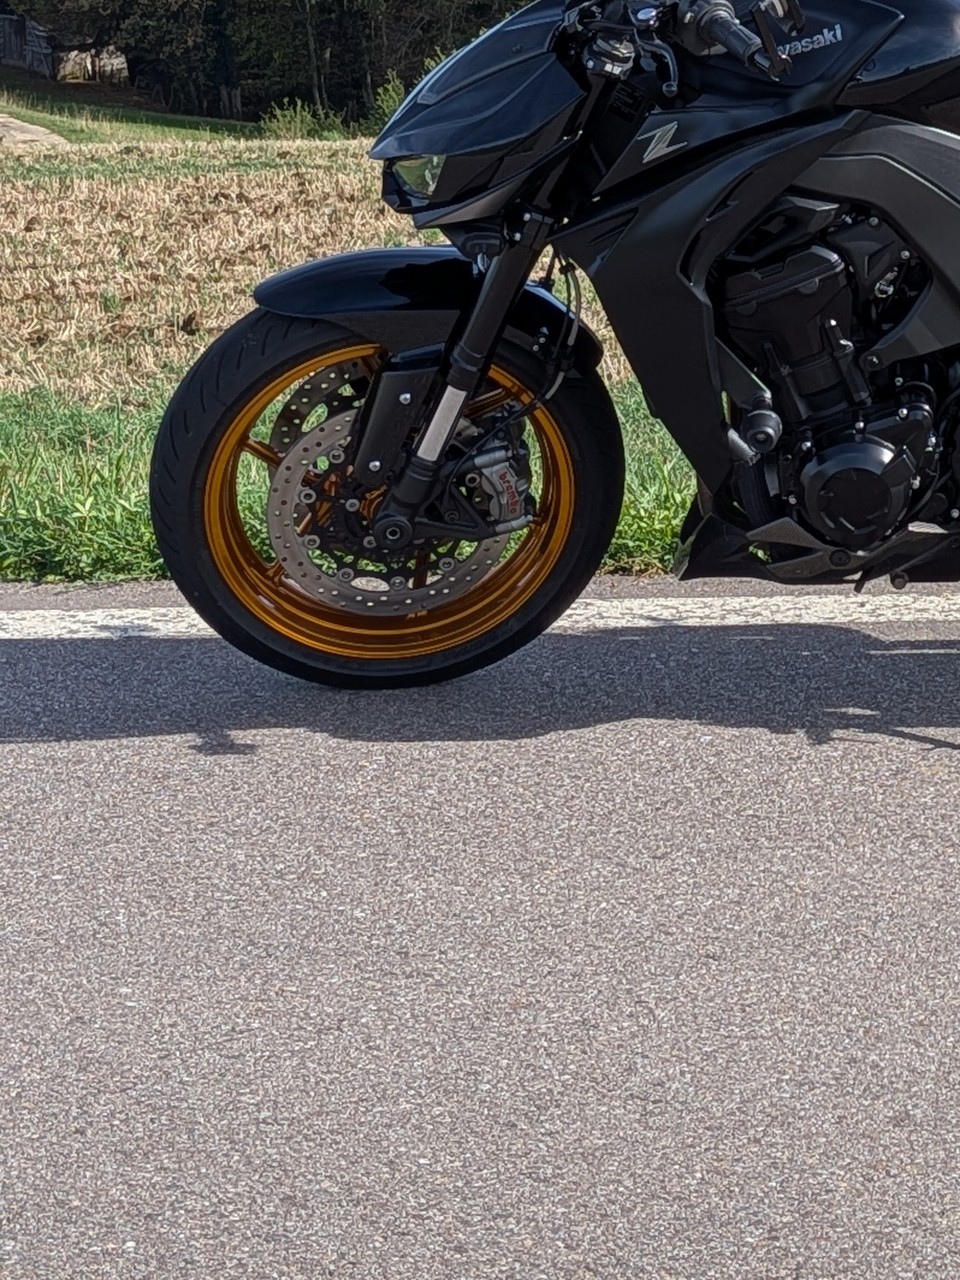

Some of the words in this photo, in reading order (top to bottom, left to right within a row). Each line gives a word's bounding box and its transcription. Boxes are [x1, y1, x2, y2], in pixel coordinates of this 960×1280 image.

[777, 24, 843, 56] wasaki
[637, 121, 688, 163] Z
[500, 472, 518, 513] brembo
